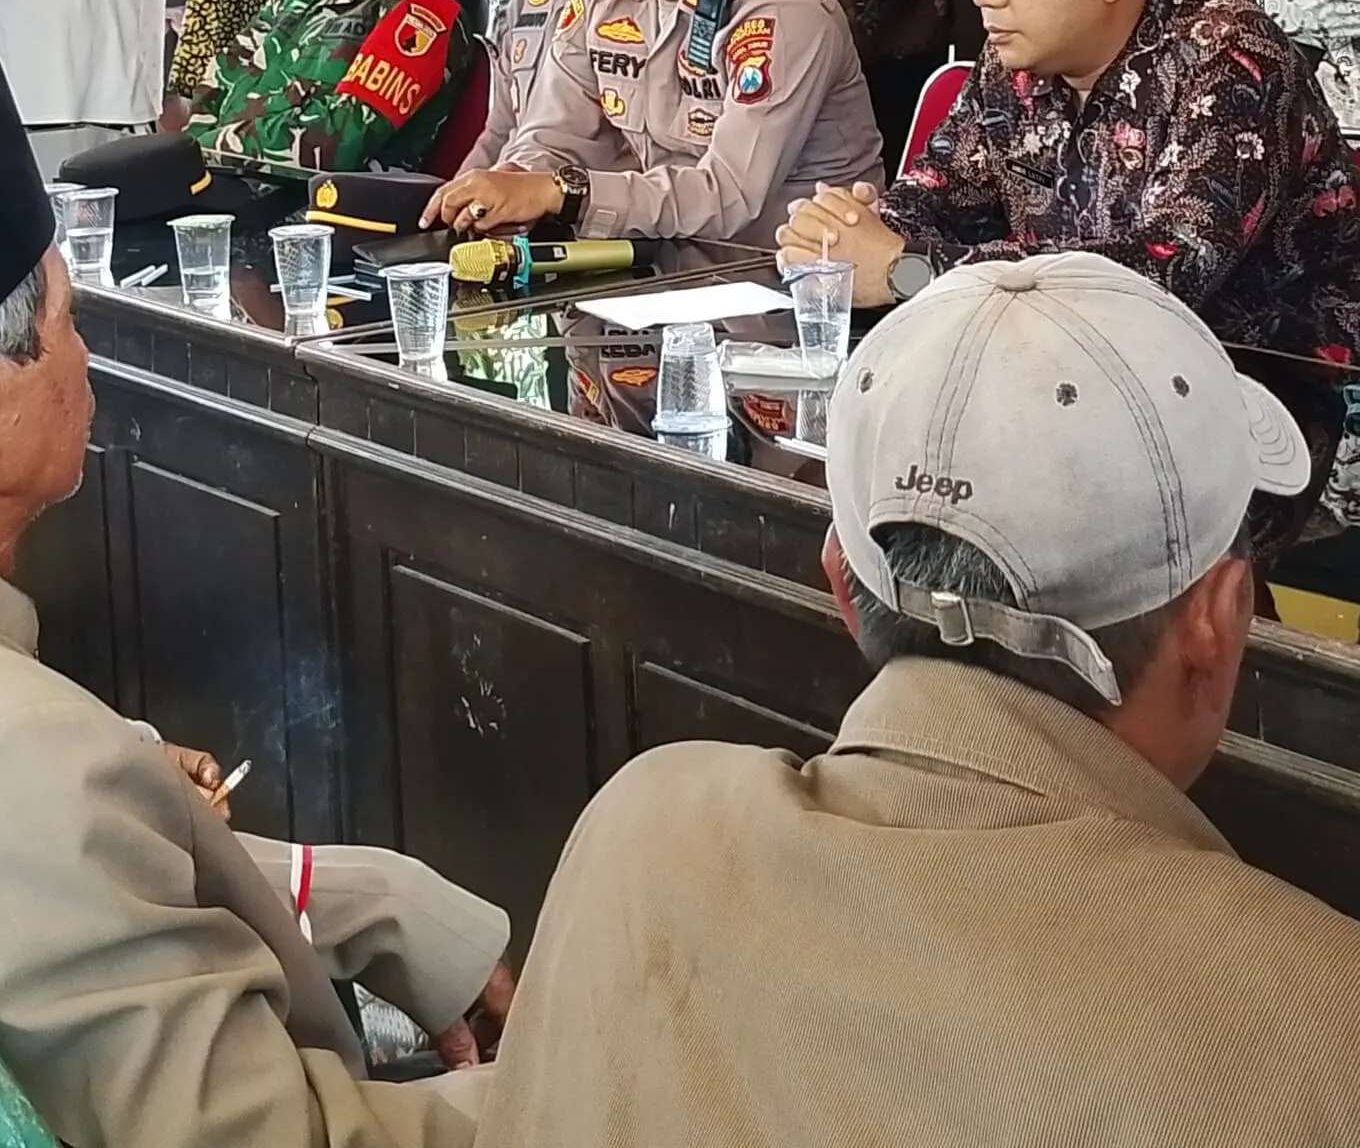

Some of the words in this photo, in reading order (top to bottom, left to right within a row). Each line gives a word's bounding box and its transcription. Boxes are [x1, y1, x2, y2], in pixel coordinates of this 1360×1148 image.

[341, 53, 428, 114] BABINS
[679, 75, 721, 100] OLRI
[894, 464, 973, 505] Jeep
